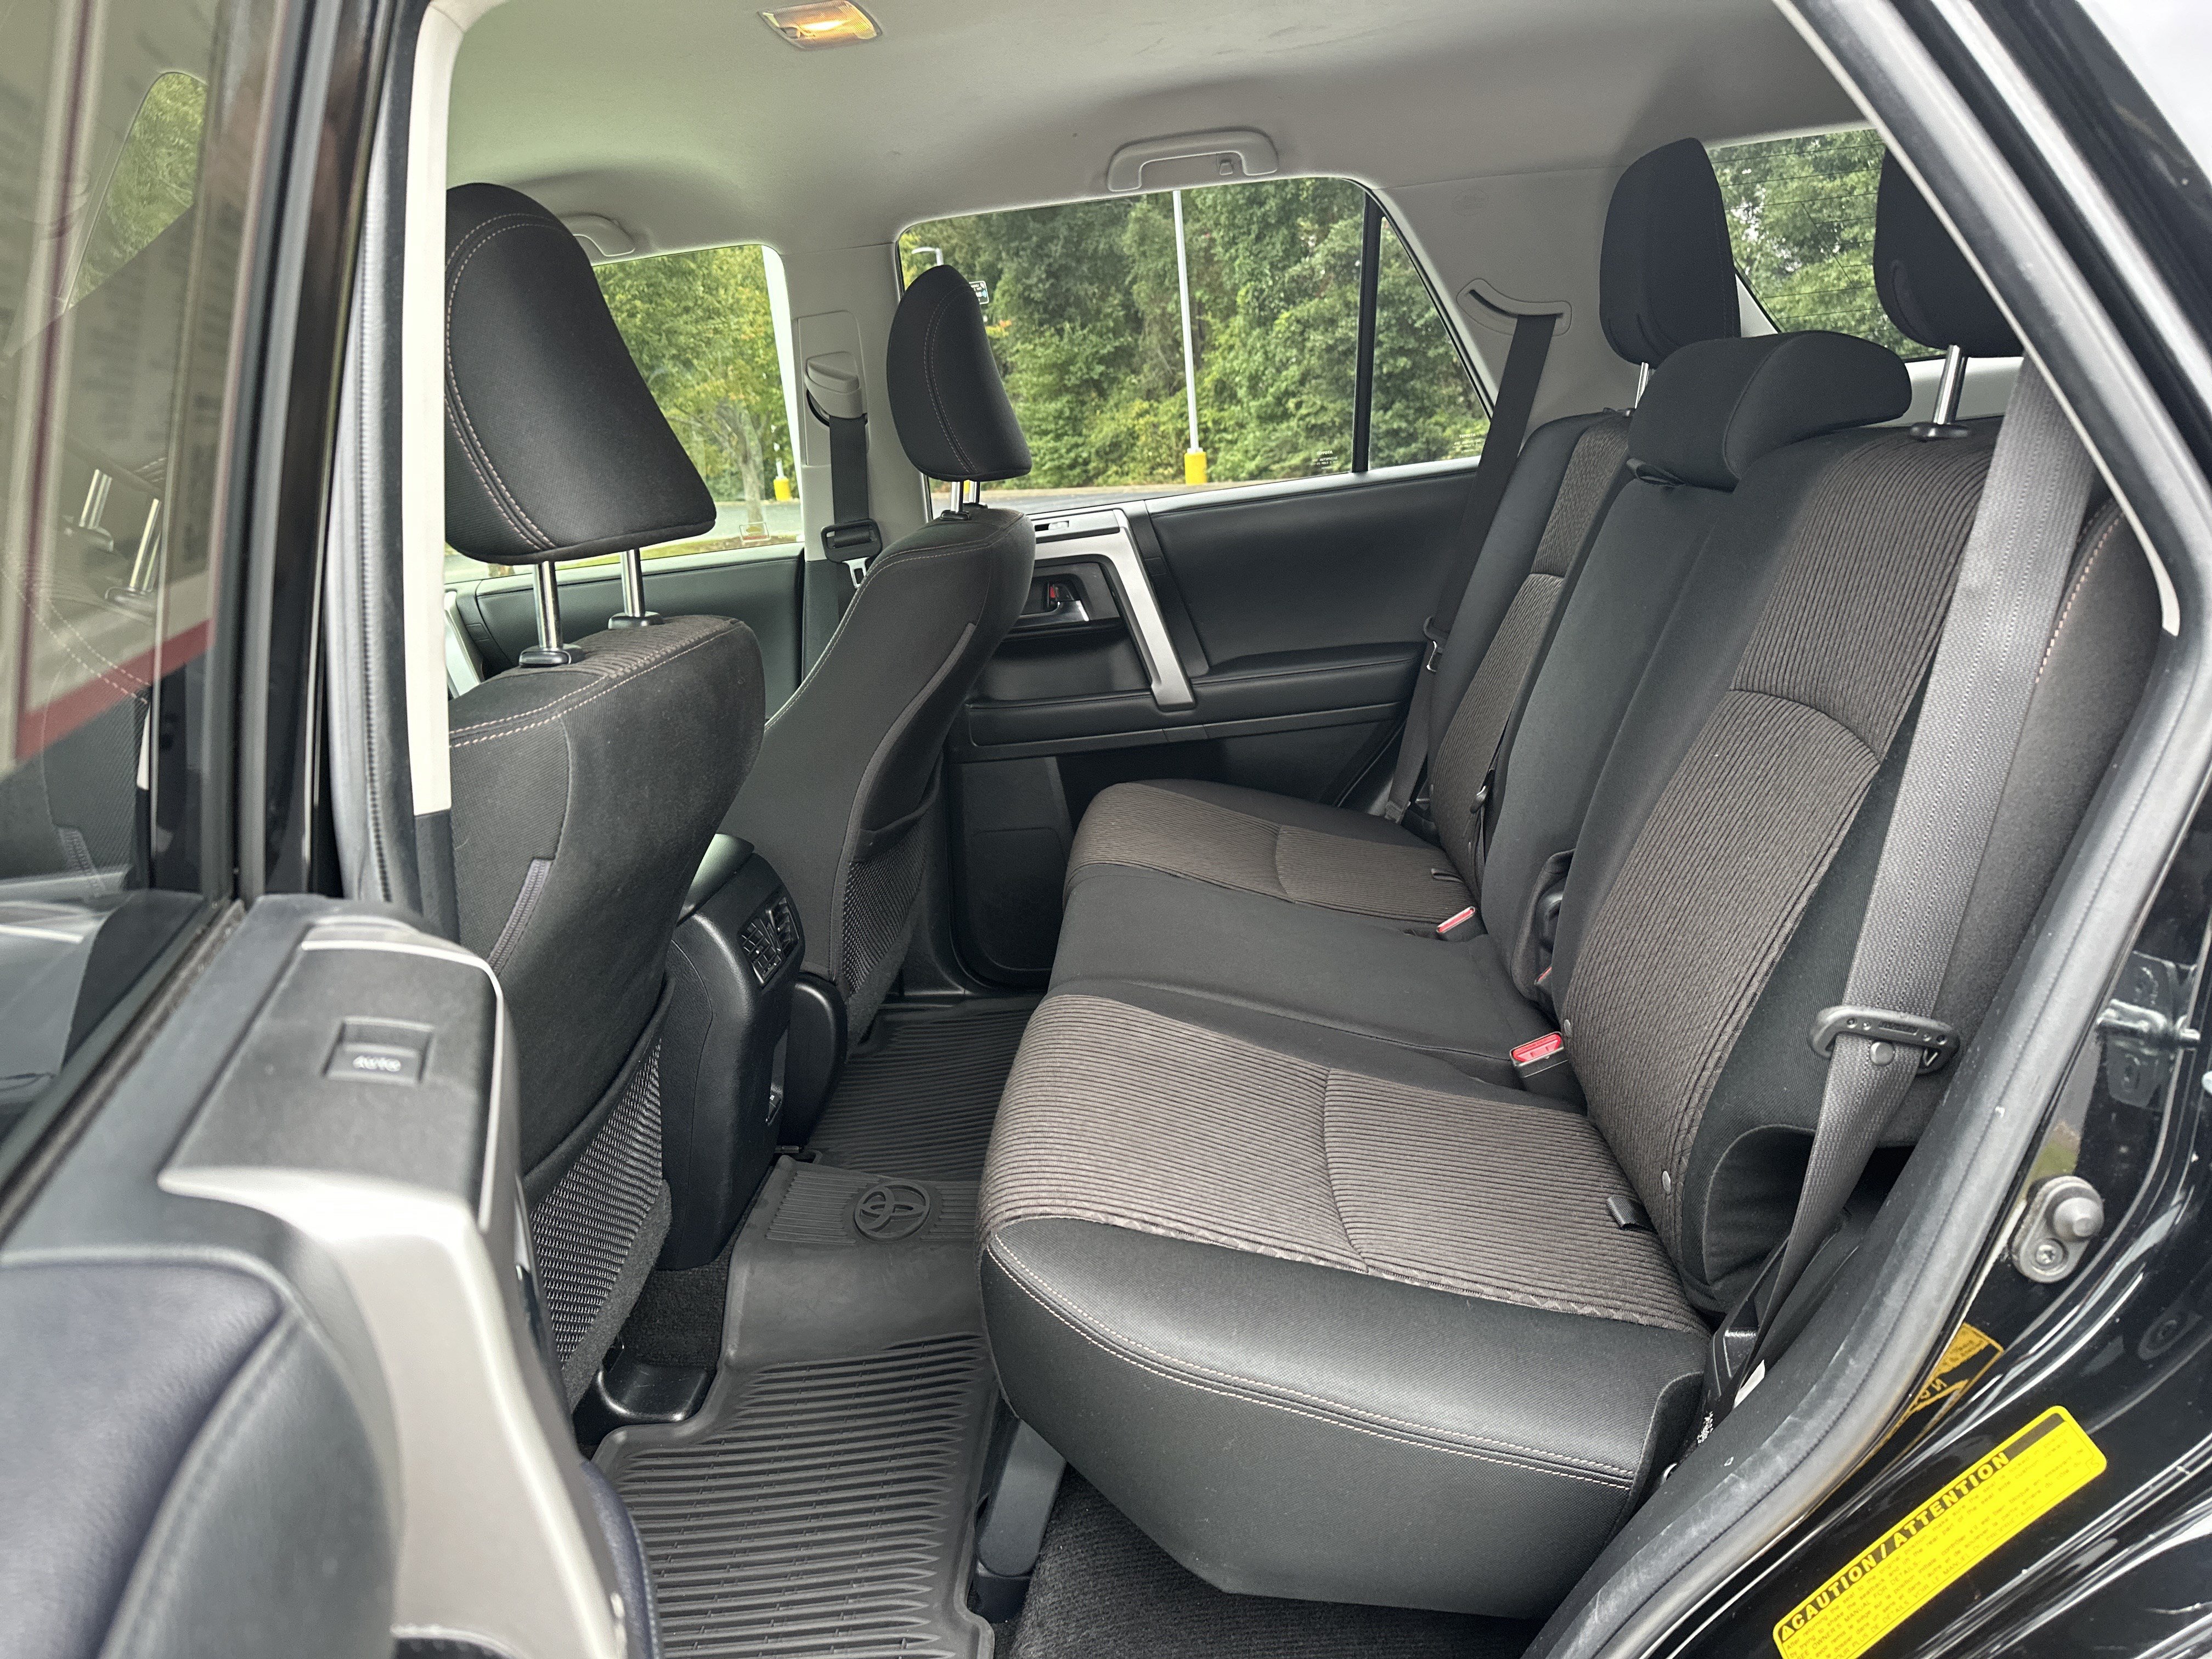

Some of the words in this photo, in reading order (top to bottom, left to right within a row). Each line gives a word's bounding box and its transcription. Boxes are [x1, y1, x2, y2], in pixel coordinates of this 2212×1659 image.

[353, 1056, 401, 1072] AUTO
[1792, 1554, 1877, 1630] CAUTION
[1893, 1451, 2010, 1548] ATTENTION
